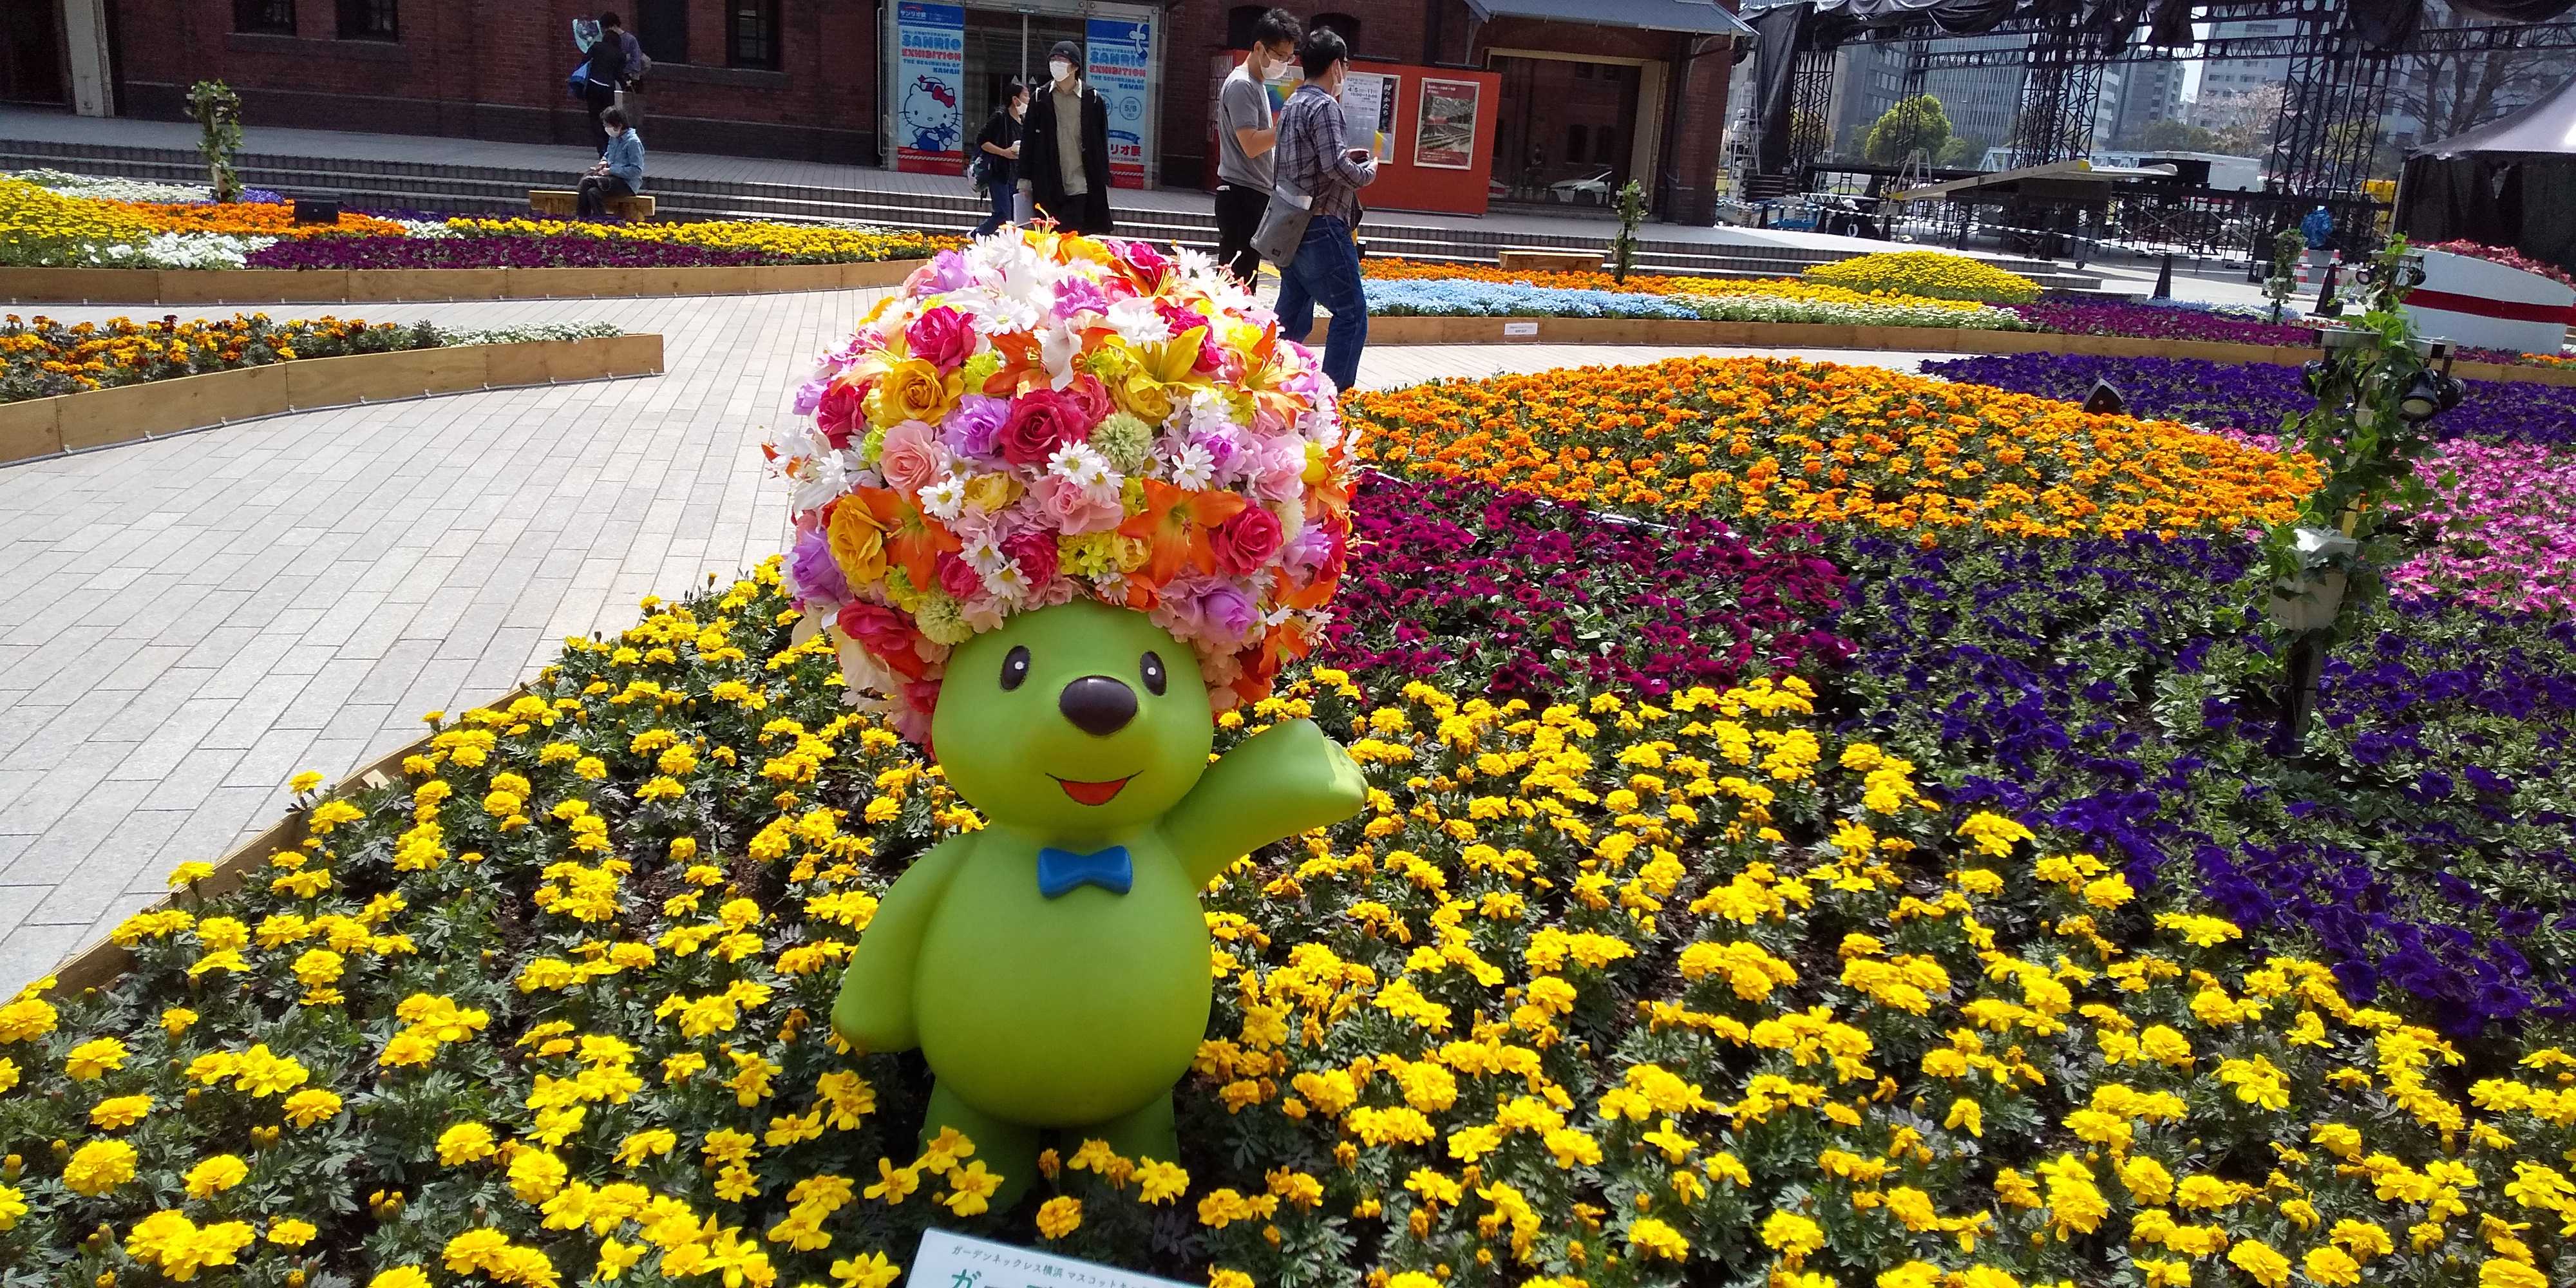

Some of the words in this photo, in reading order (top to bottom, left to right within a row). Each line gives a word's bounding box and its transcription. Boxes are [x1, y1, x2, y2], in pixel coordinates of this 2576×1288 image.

[902, 34, 961, 50] SANRIO
[902, 48, 961, 61] EXHIBITION
[1090, 51, 1146, 67] SANRIO
[1090, 65, 1146, 77] EXHIBITION
[1110, 144, 1141, 156] リオ展
[952, 1245, 1063, 1278] ガーデンネックレス横浜
[1068, 1271, 1148, 1288] マスコットキ
